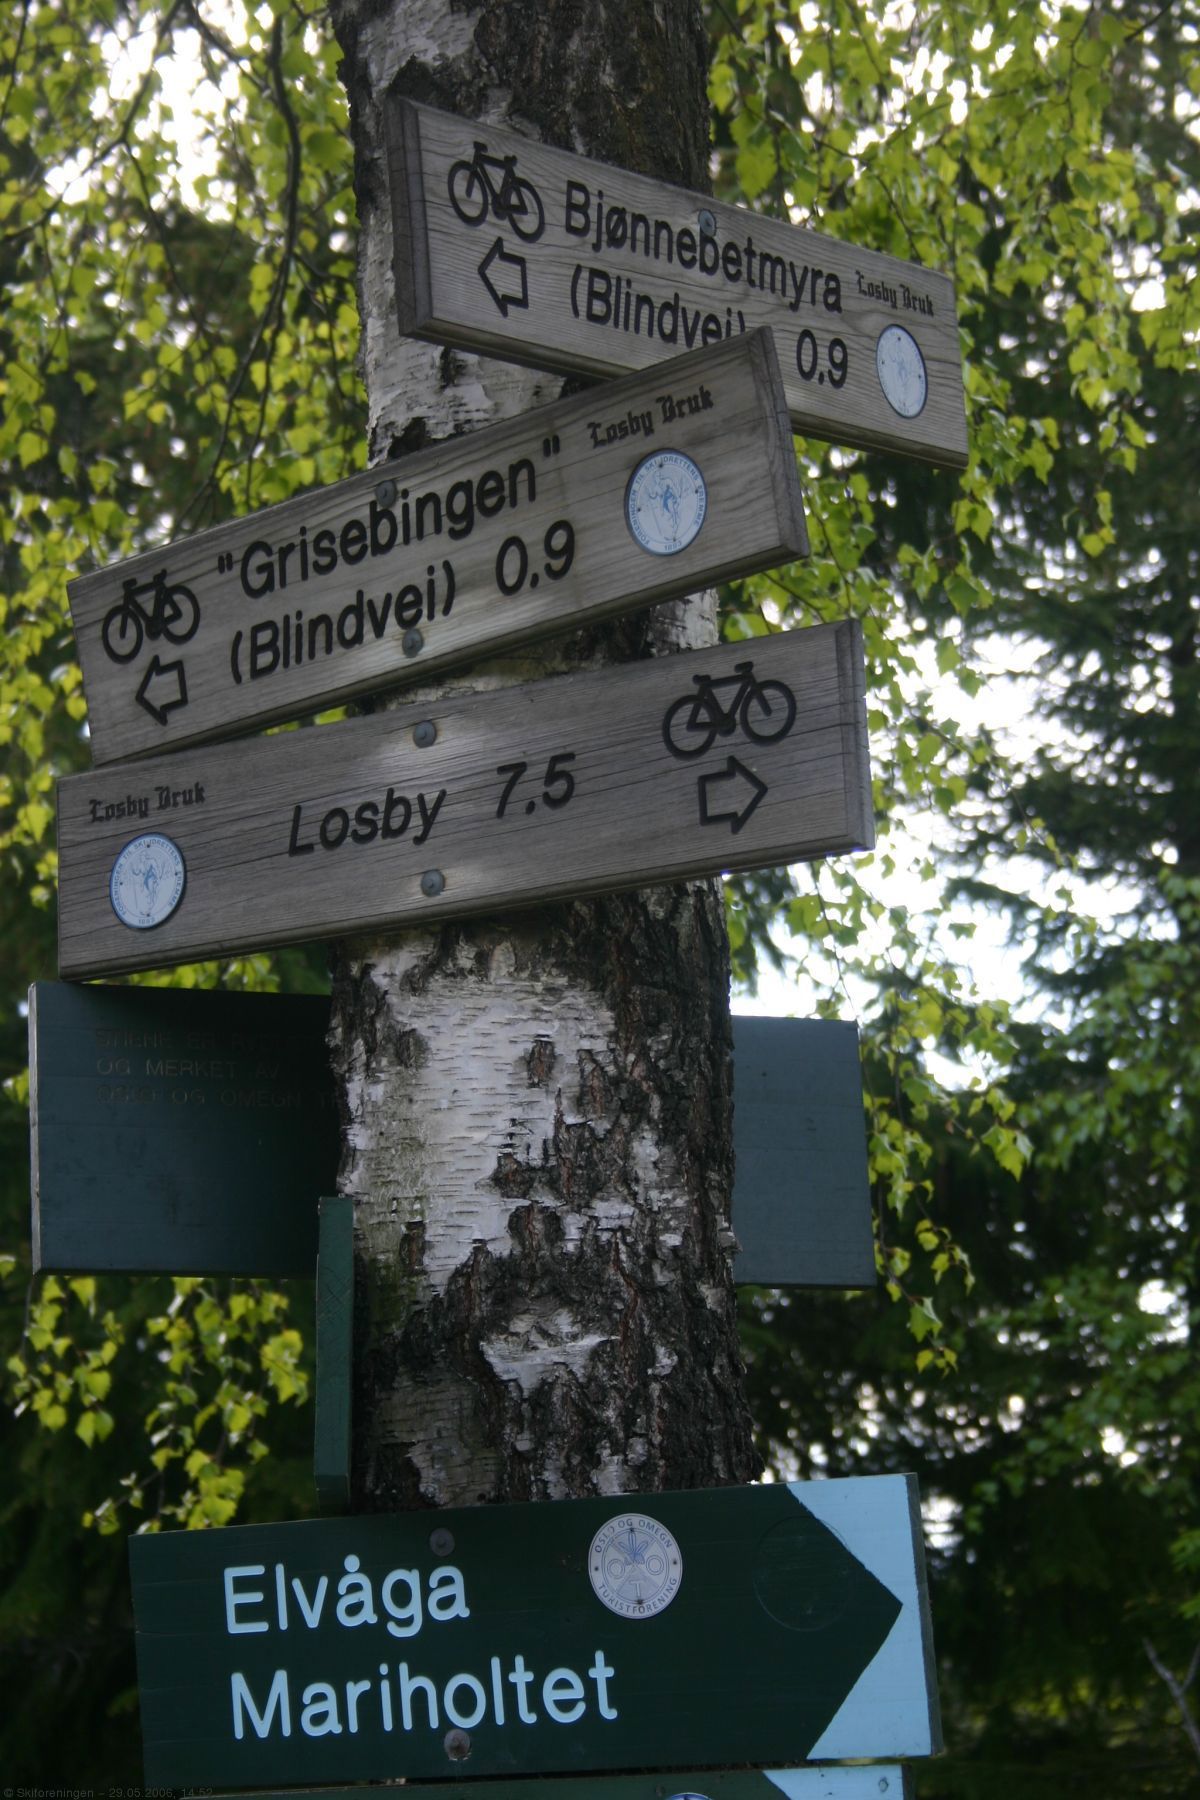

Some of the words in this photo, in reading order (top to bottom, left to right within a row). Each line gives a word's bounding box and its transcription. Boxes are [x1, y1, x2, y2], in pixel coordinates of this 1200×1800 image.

[565, 180, 843, 313] Bjønnebetmyra
[796, 329, 849, 388] 0.9
[230, 557, 456, 685] (Blindvei)
[494, 519, 576, 597] 0.9
[287, 785, 448, 858] Losby
[494, 752, 578, 820] 7.5
[145, 1058, 238, 1080] MERKET
[617, 1518, 634, 1529] OG
[638, 1518, 674, 1549] OMEGN
[223, 1553, 471, 1639] Elvåga
[598, 1576, 678, 1615] TURISTFORENING
[230, 1648, 619, 1741] Mariholtet
